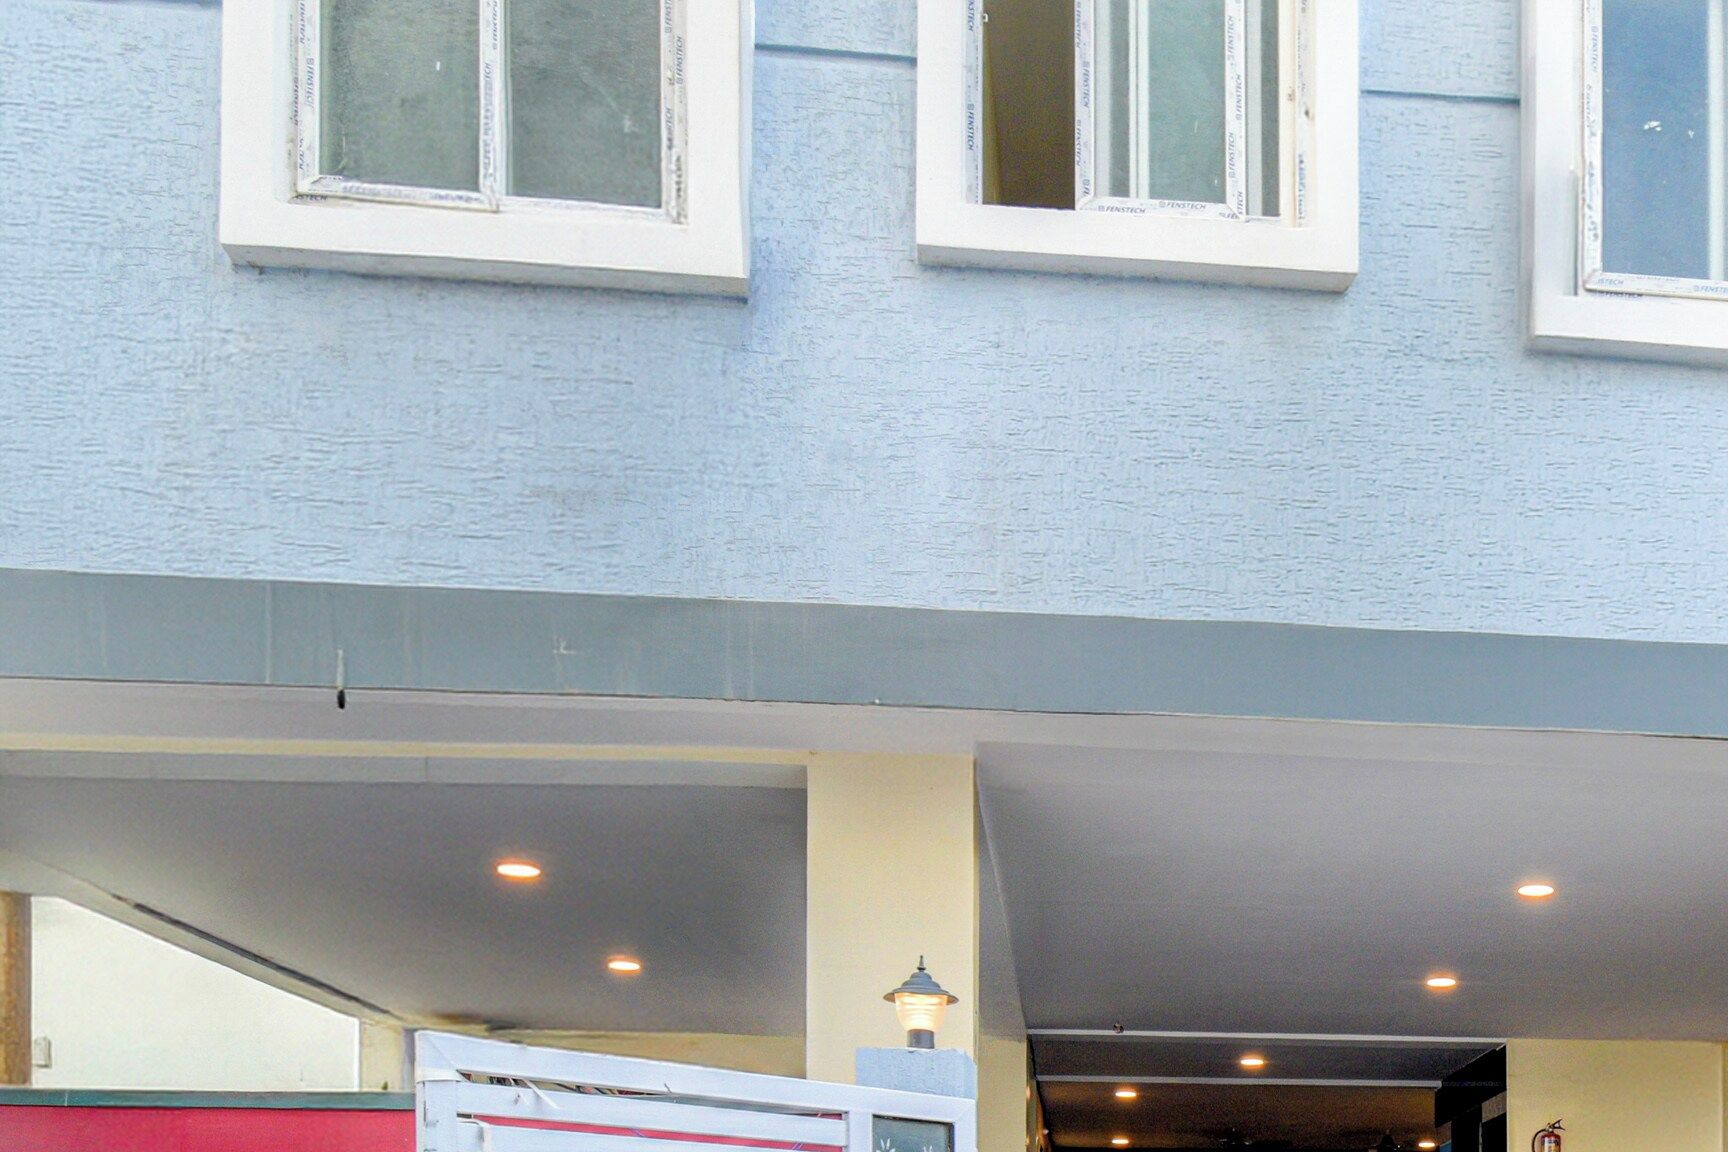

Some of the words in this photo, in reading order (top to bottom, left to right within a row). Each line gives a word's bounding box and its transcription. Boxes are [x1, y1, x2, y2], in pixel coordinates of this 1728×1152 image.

[665, 0, 673, 27] FENST
[967, 0, 975, 32] NSTECH
[1227, 15, 1235, 54] FENSTECH
[1235, 74, 1243, 113] FENSTECH
[967, 111, 975, 151] FENSTECH
[1105, 205, 1146, 214] FENSTECH
[1167, 202, 1206, 210] FENSTECH
[1598, 278, 1624, 286] STECH
